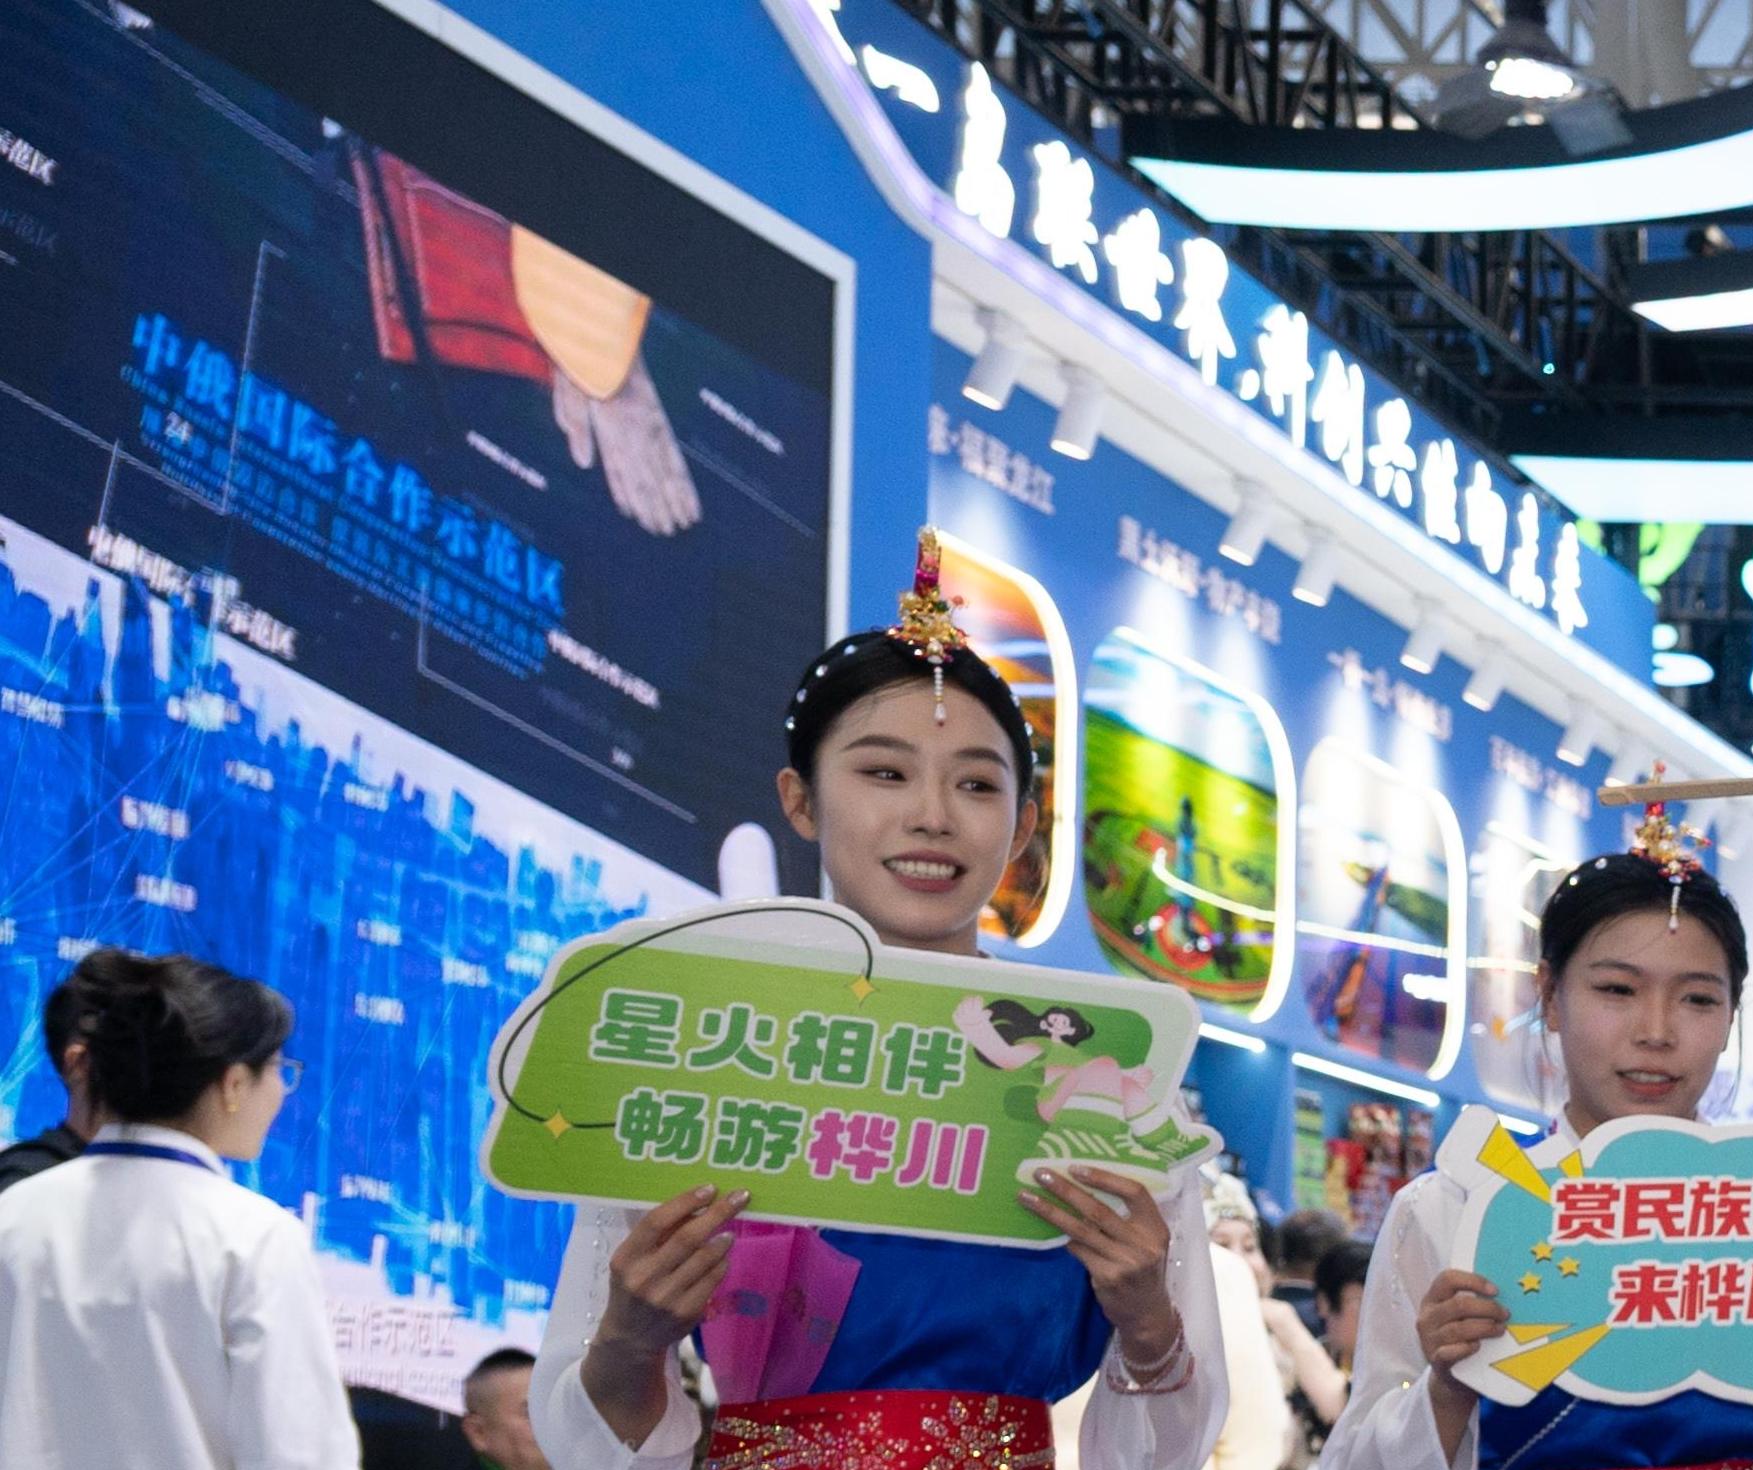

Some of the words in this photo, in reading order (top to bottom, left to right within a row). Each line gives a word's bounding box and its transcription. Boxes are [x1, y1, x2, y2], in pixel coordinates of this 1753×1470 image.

[590, 992, 967, 1097] 星火相伴
[616, 1090, 987, 1192] 畅游桦川
